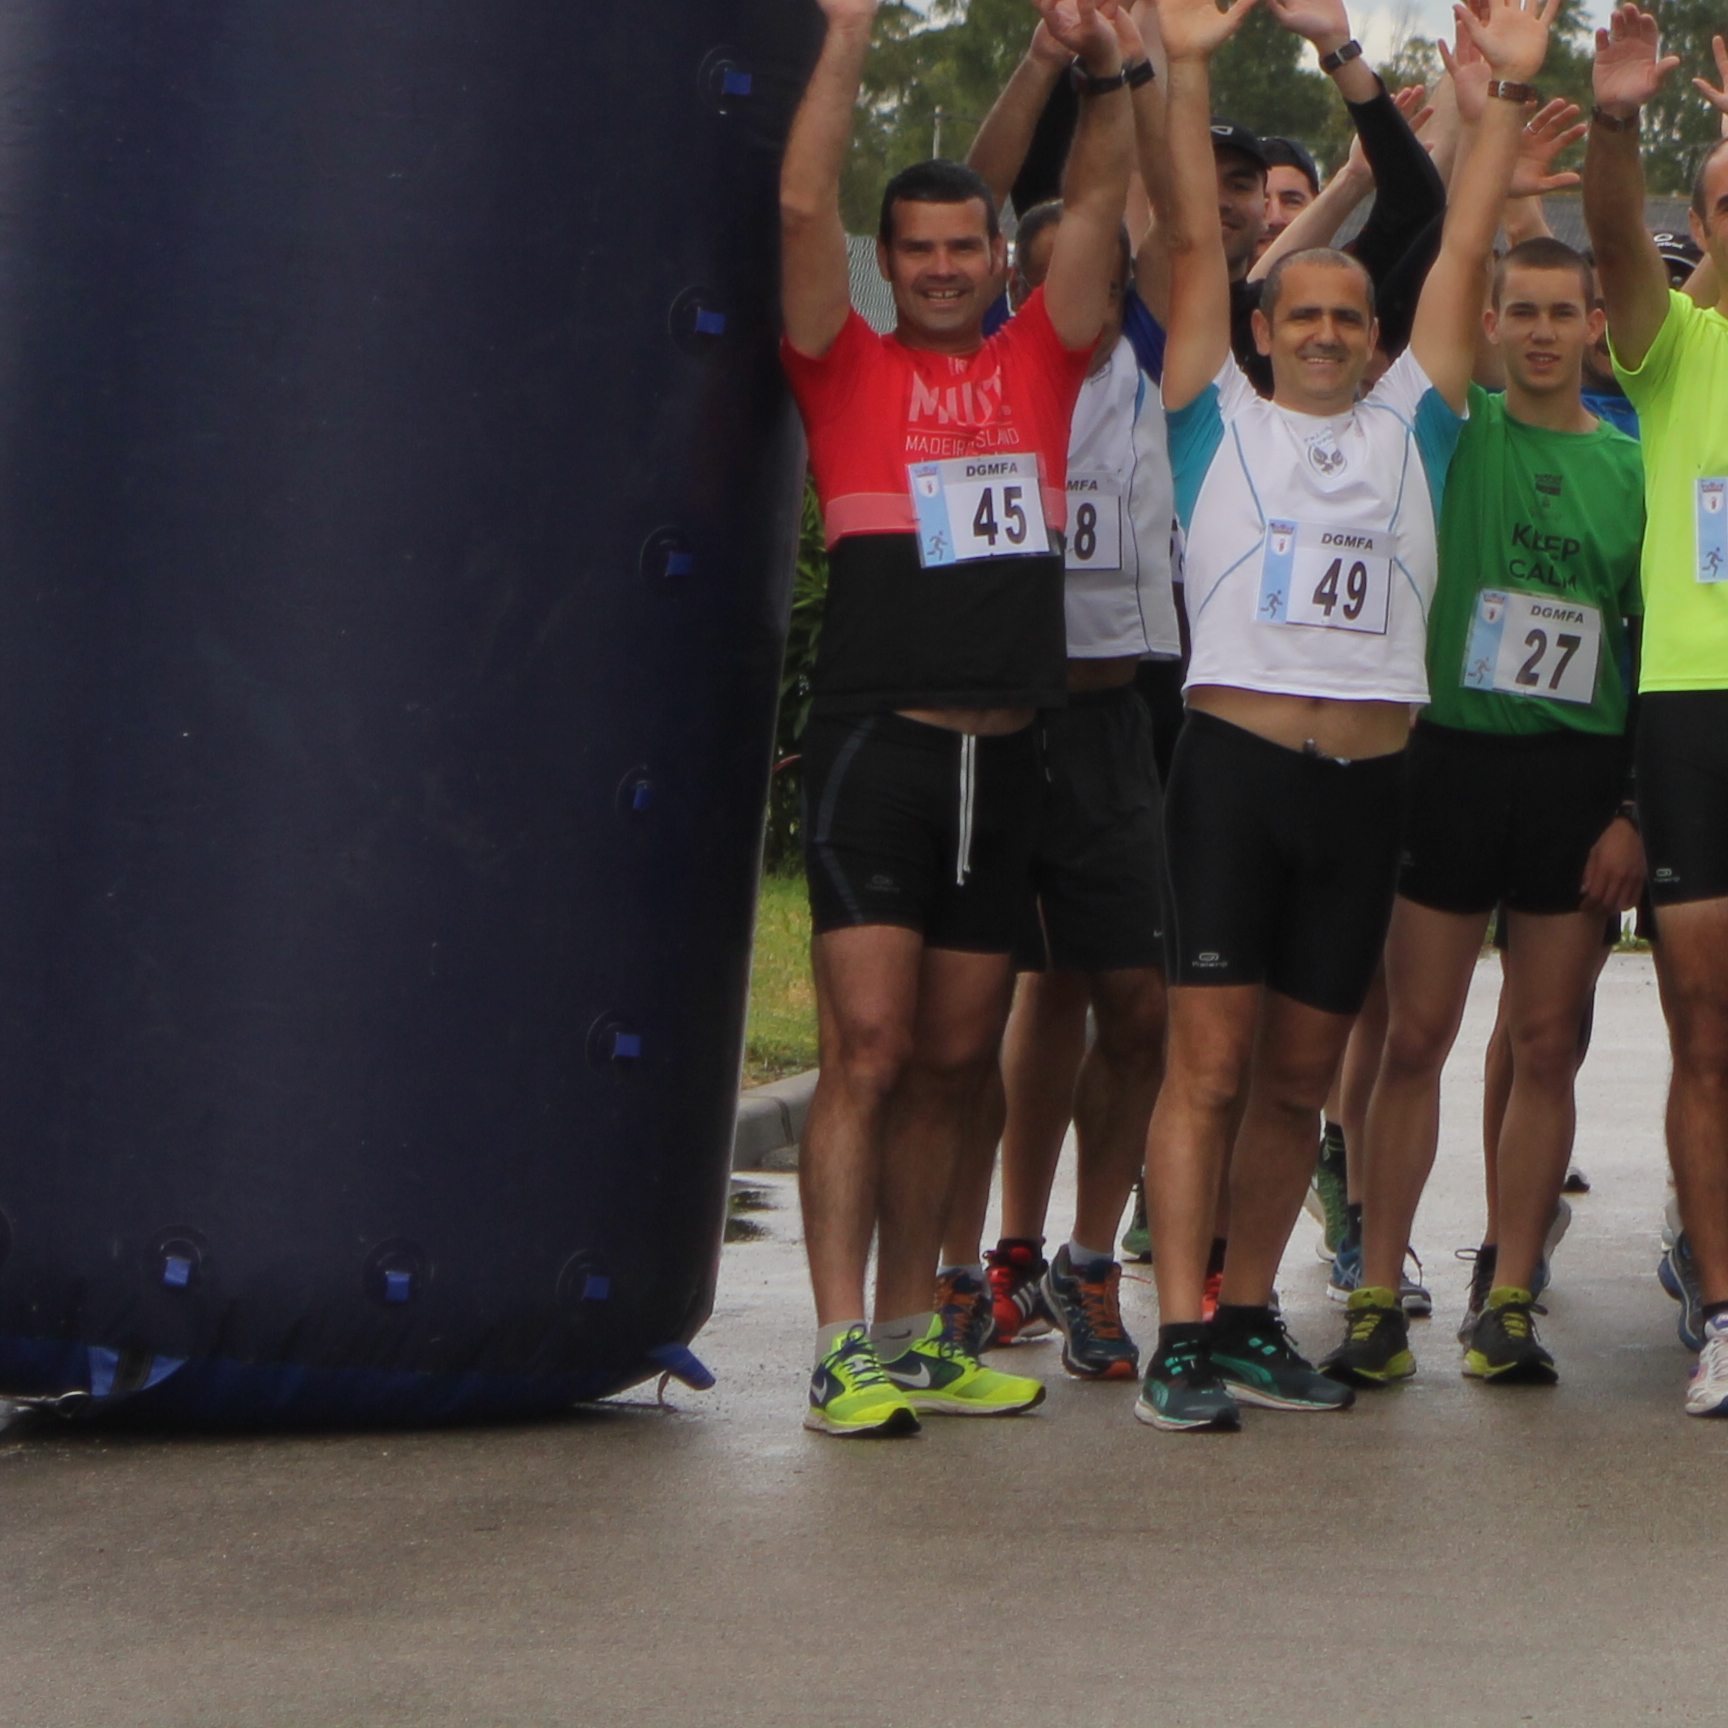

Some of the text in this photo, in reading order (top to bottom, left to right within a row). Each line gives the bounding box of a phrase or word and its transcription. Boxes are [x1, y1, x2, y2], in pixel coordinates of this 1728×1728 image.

[966, 462, 1018, 477] DGMFA
[1067, 479, 1098, 491] MFA
[973, 486, 1027, 546] 45
[1321, 533, 1374, 551] DGMFA
[1511, 522, 1581, 563] KEEP
[1312, 558, 1368, 621] 49
[1530, 604, 1584, 624] DGMFA
[1515, 628, 1581, 691] 27
